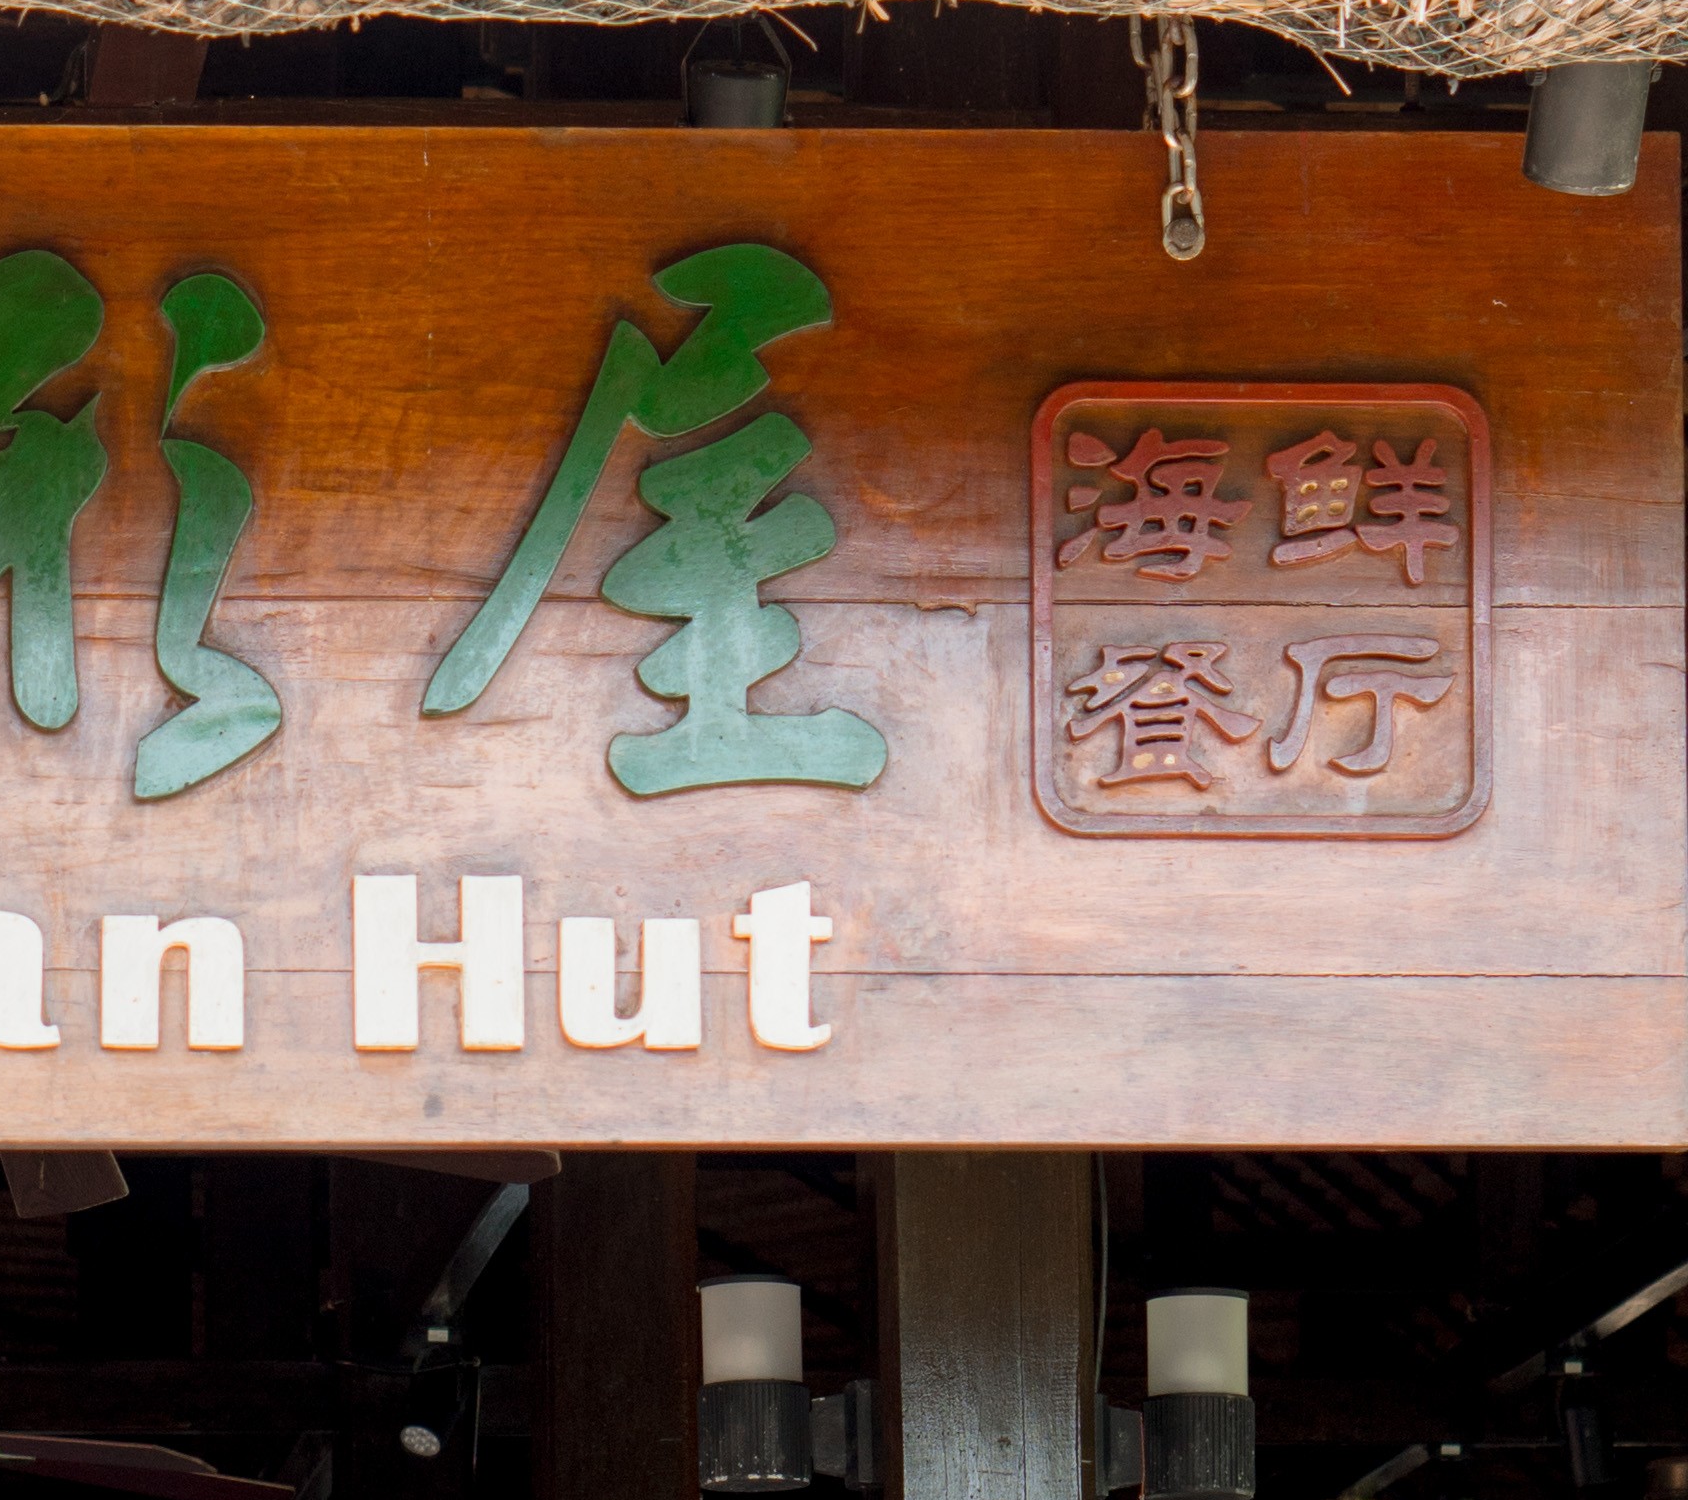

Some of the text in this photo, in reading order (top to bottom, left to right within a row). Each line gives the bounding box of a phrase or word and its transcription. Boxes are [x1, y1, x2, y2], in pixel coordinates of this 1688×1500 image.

[1058, 427, 1460, 587] 海鲜
[1065, 633, 1458, 791] 餐厅
[352, 872, 835, 1052] Hut
